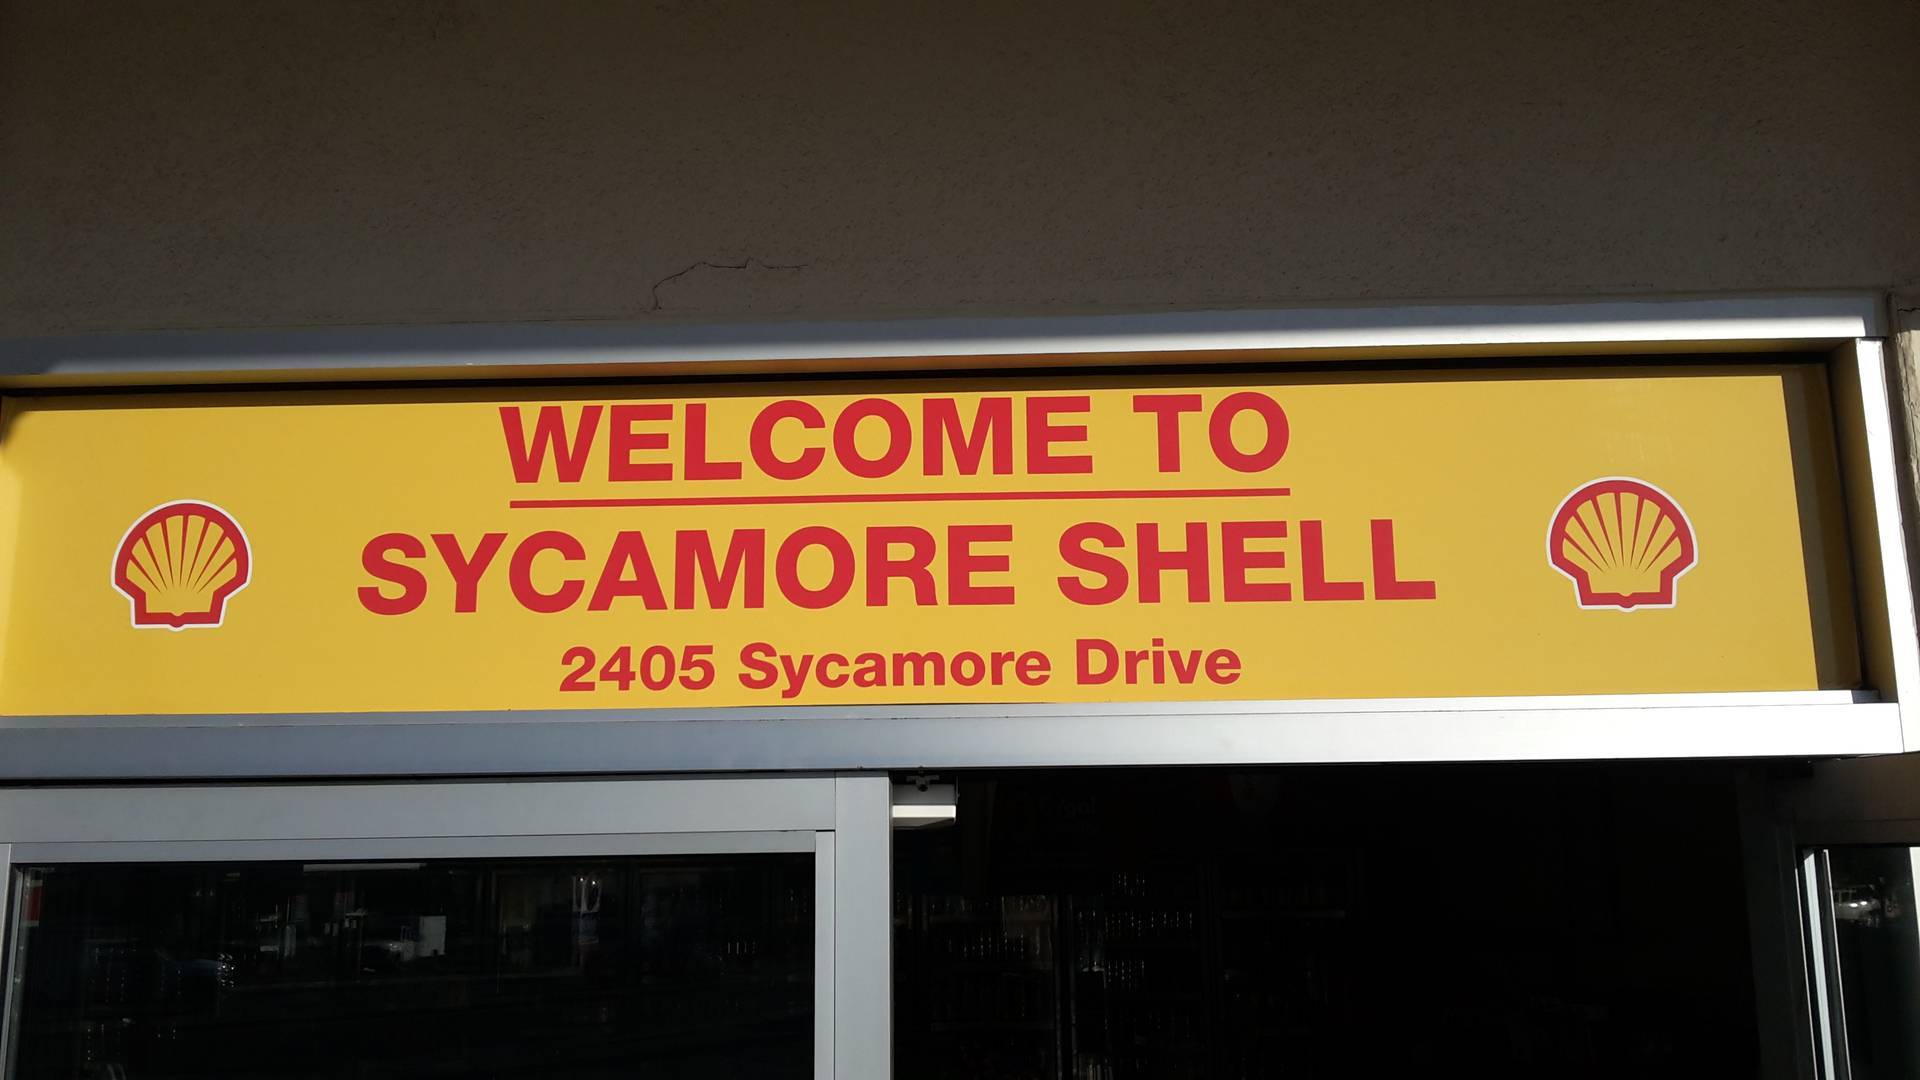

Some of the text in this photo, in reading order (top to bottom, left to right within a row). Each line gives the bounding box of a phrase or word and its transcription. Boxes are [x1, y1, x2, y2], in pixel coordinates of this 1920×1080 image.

[499, 392, 1290, 484] WELCOME TO
[358, 519, 1436, 616] SYCAMORE SHELL
[560, 639, 1242, 699] 2405 Sycamore Drive
